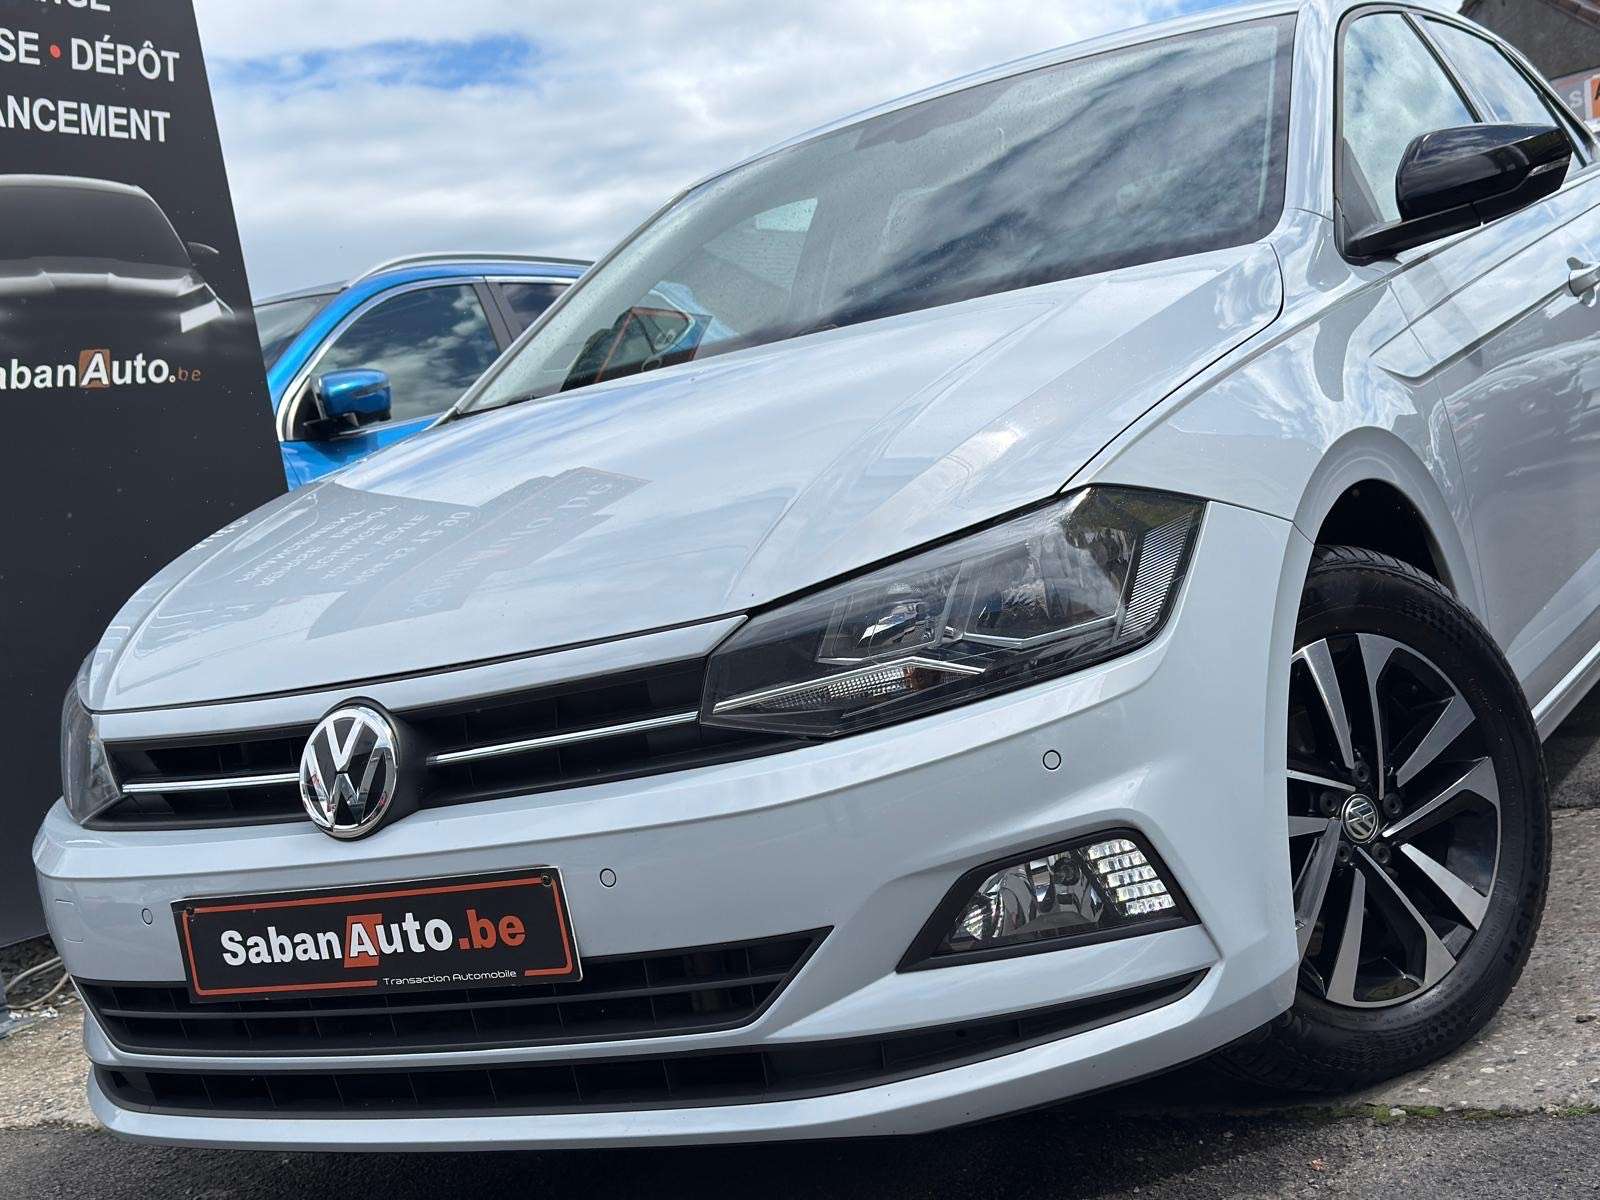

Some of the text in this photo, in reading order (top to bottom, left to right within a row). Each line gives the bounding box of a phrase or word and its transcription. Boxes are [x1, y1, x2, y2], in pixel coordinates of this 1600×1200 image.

[71, 34, 180, 82] DÉPÔT
[0, 95, 171, 142] NCEMENT
[383, 969, 518, 986] Transaction Automobile
